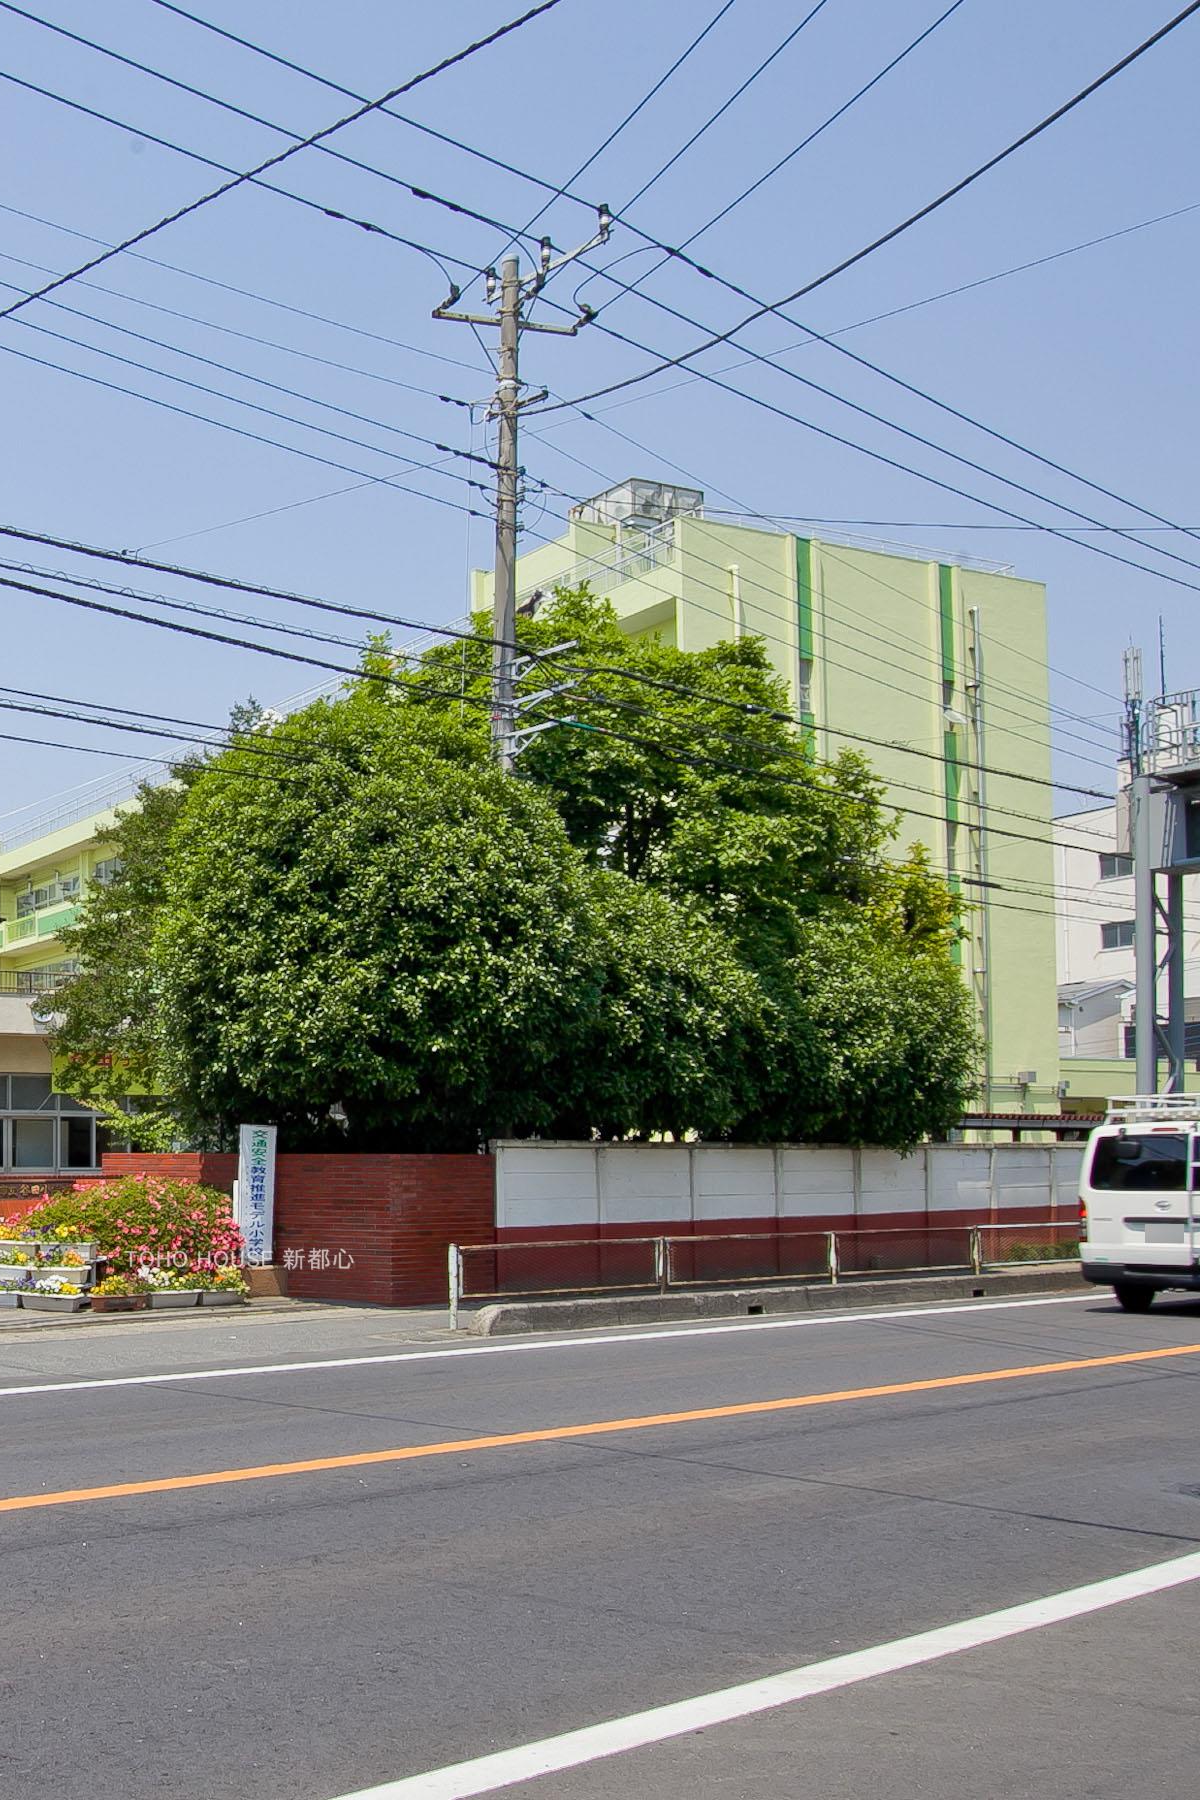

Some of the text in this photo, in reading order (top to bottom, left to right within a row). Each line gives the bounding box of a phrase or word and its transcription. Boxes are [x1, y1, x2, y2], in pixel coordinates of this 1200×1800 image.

[248, 1129, 268, 1256] 交通安全教育推進モデル小学校
